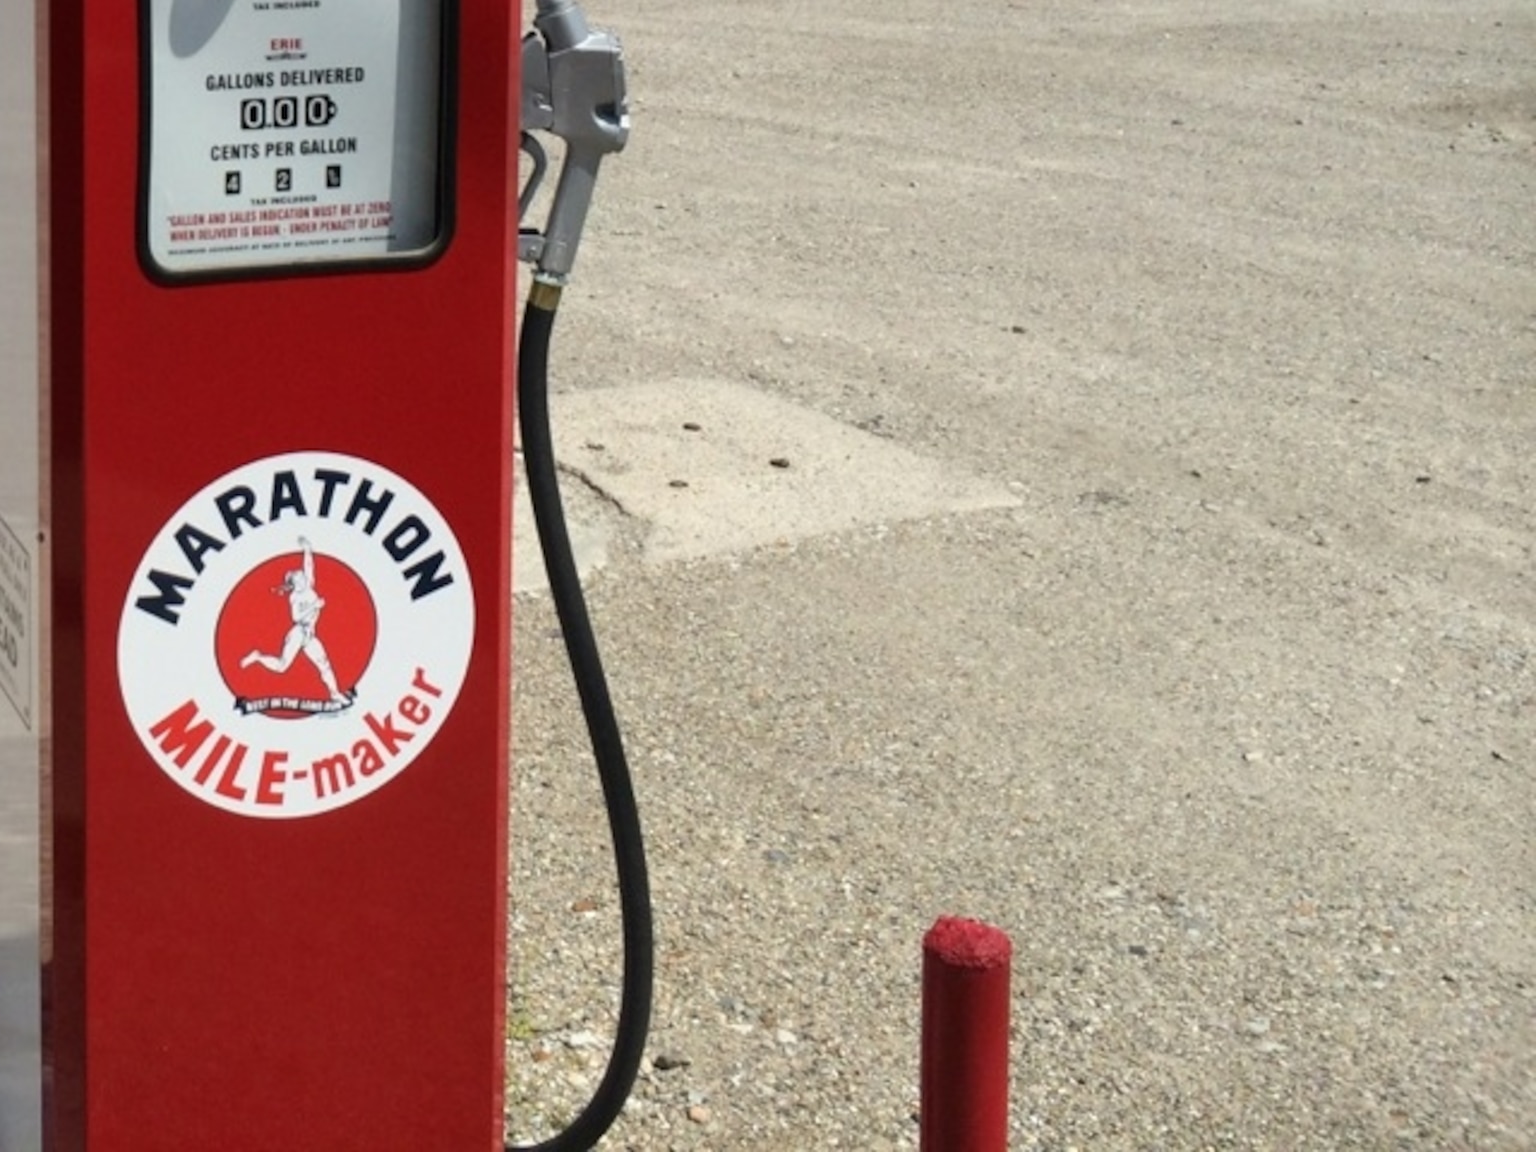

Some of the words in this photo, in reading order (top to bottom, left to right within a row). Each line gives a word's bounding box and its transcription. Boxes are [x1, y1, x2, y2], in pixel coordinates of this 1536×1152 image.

[270, 38, 302, 51] ERIE
[206, 71, 275, 91] GALLONS
[280, 66, 365, 87] DELIVERED
[210, 143, 260, 161] CENTS
[265, 141, 295, 157] PER
[300, 137, 357, 155] GALLON
[226, 171, 240, 194] 4
[276, 169, 290, 191] 2
[208, 212, 226, 224] AND
[340, 204, 351, 216] BE
[198, 227, 238, 240] DELIVERY
[134, 469, 454, 626] MARATHON
[148, 667, 443, 805] MILE-maker
